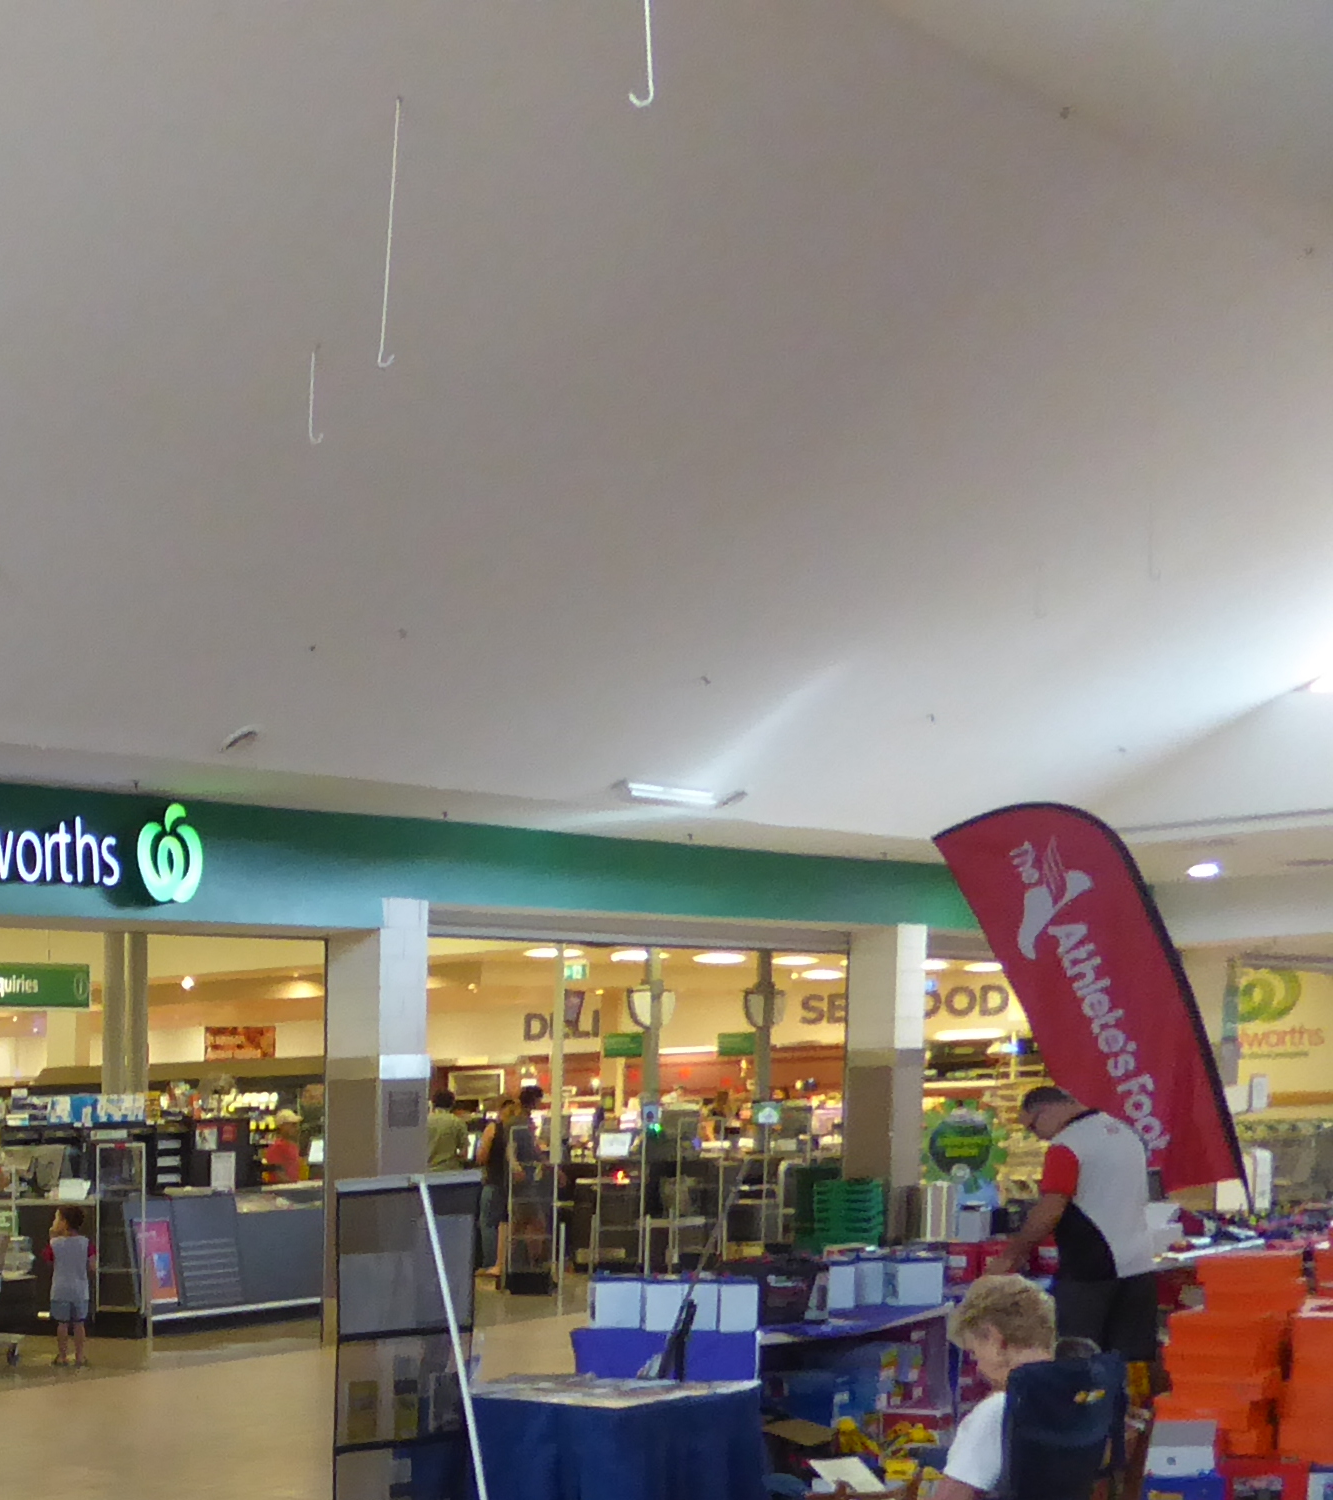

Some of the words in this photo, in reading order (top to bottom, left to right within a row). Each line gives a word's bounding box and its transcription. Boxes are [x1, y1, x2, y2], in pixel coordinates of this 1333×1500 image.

[1009, 841, 1039, 883] The
[523, 1010, 599, 1041] DLI
[1047, 922, 1138, 1077] Athlete's
[1117, 1073, 1171, 1151] Foot
